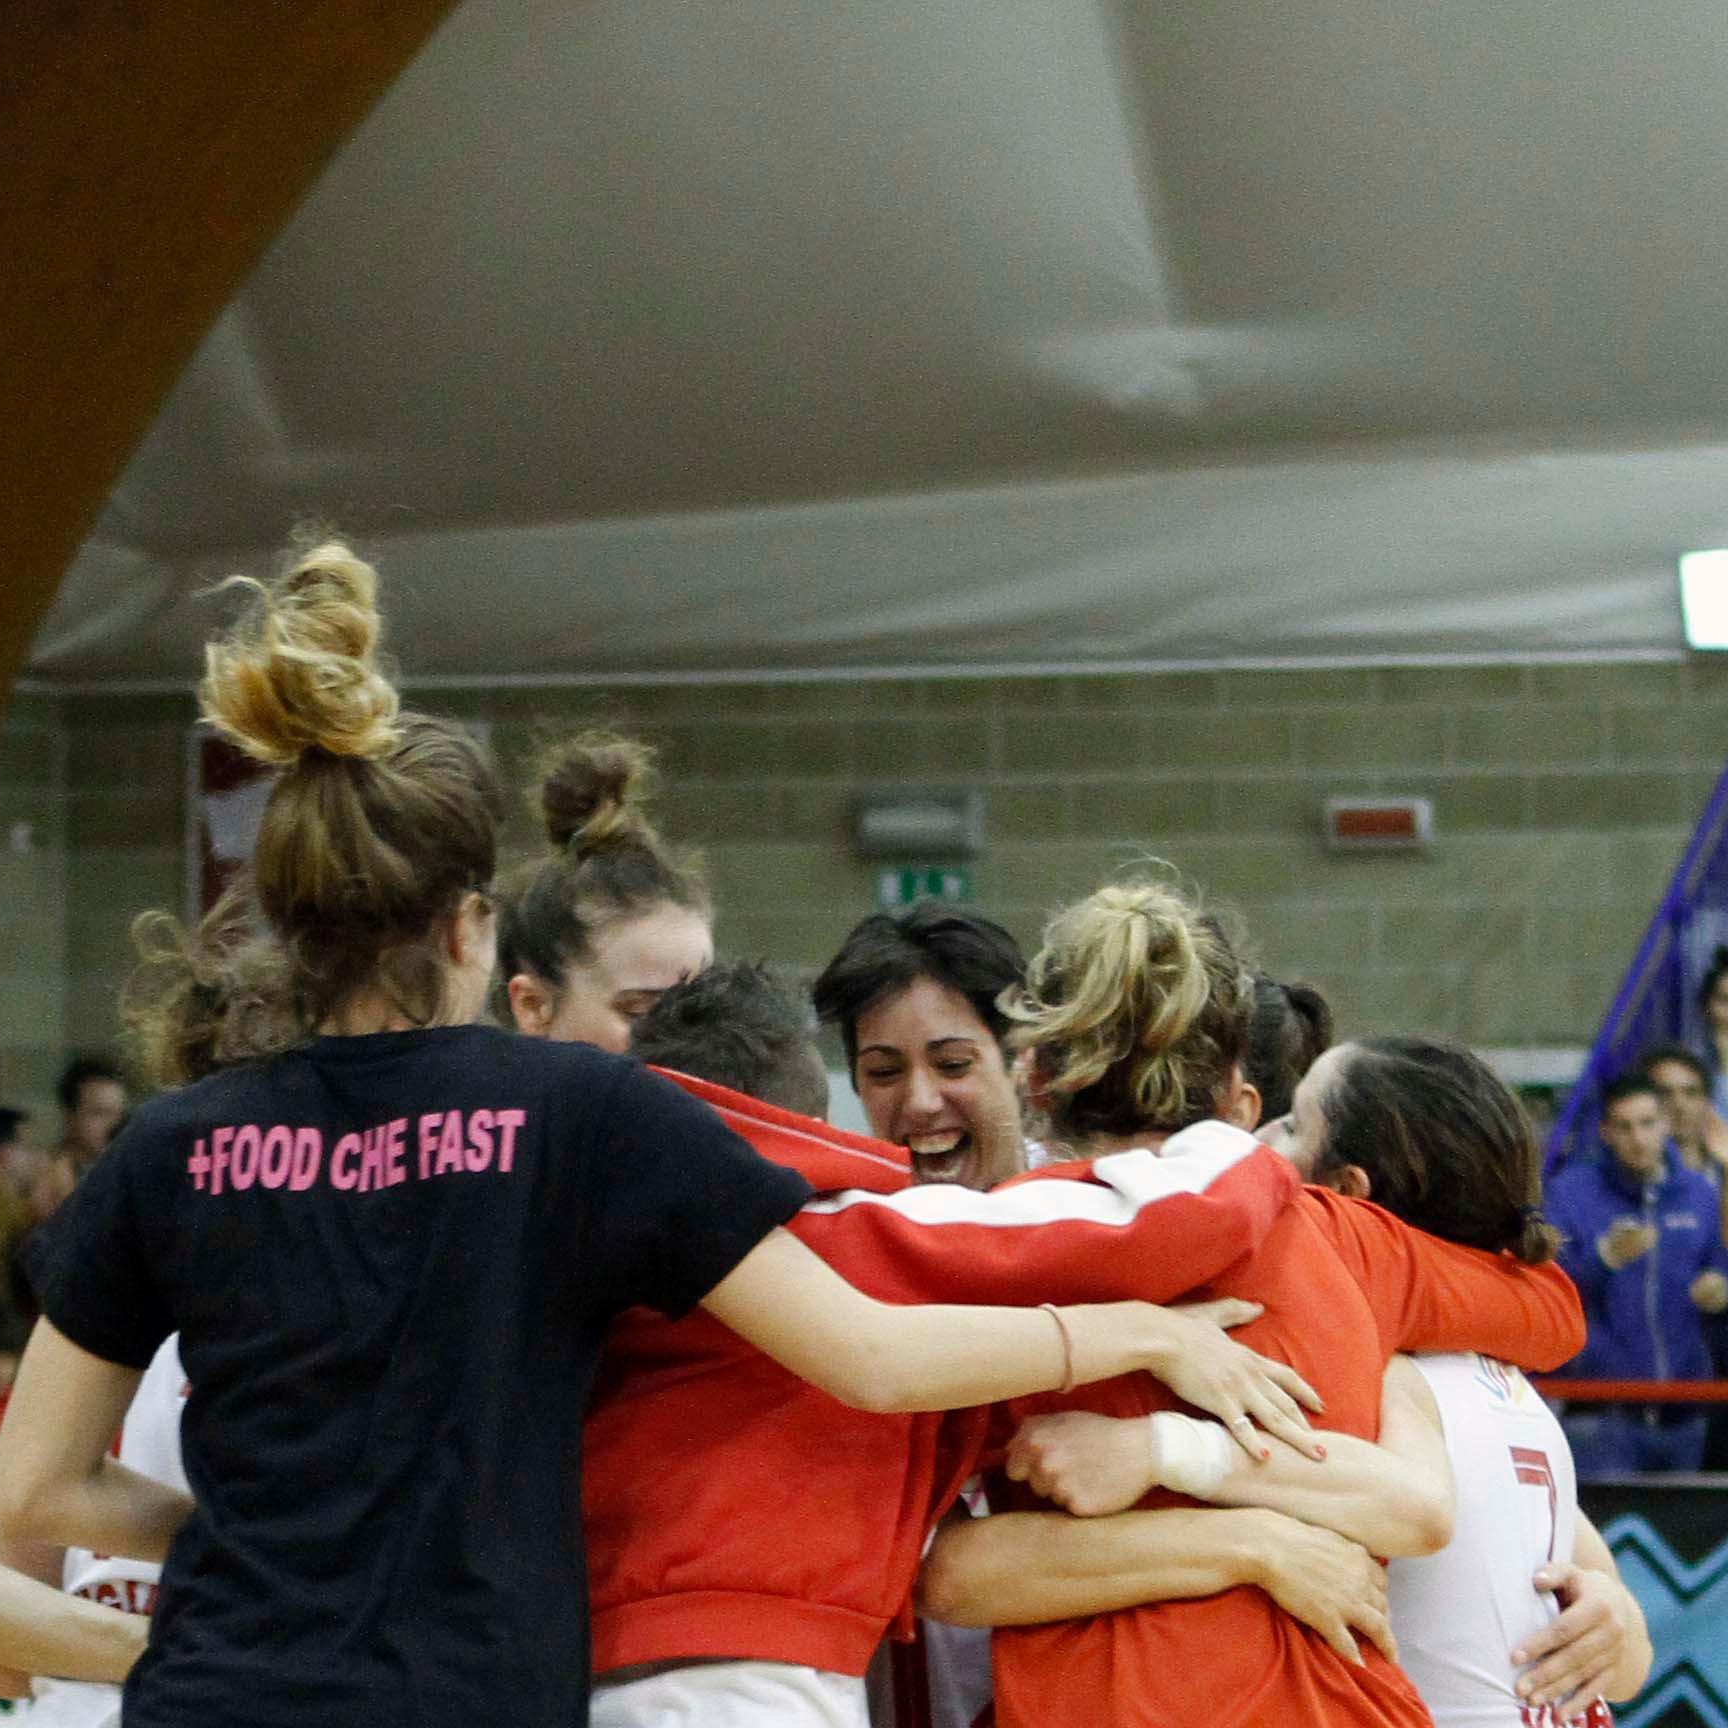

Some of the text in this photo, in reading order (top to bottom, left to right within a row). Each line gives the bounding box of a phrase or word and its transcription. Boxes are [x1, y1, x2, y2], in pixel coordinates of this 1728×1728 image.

[187, 1109, 526, 1196] +FOOD CHE FAST
